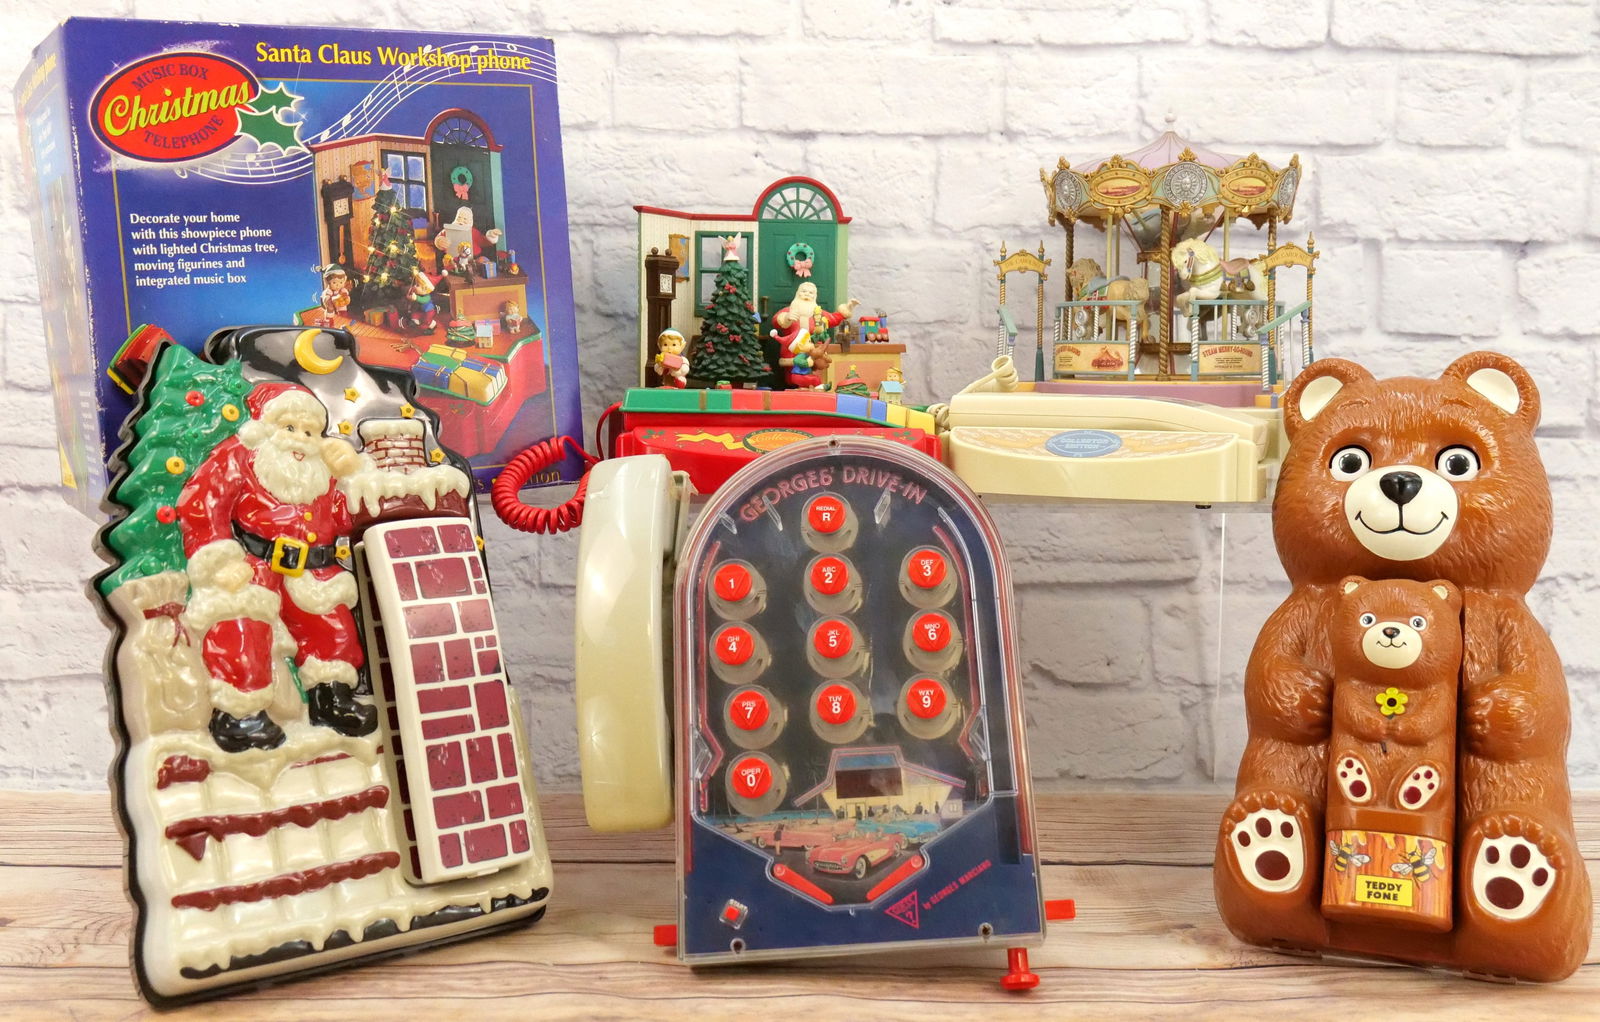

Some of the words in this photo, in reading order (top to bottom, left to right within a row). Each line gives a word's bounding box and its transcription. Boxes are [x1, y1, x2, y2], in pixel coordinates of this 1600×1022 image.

[256, 42, 312, 63] Santa
[318, 43, 372, 65] Claus
[377, 46, 471, 73] Workshop
[477, 49, 532, 74] phone
[131, 63, 175, 91] MUSIC
[179, 63, 209, 81] BOX
[104, 81, 249, 136] Christmas
[144, 114, 224, 149] TELEPHONE
[130, 213, 180, 224] Decorate
[183, 214, 208, 226] your
[211, 212, 240, 223] home
[131, 228, 156, 239] with
[159, 228, 179, 239] this
[181, 227, 237, 241] showpiece
[240, 226, 272, 240] phone
[133, 244, 157, 255] with
[160, 243, 197, 257] lighted
[200, 242, 252, 254] Christmas
[255, 243, 278, 254] tree,
[134, 259, 175, 273] moving
[177, 258, 223, 272] figurines
[226, 257, 245, 268] and
[136, 274, 190, 289] integrated
[194, 273, 224, 284] music
[227, 272, 246, 283] box
[843, 466, 927, 504] DRIVE-IN
[822, 513, 831, 521] R
[923, 565, 932, 577] 3
[728, 578, 735, 589] 1
[824, 573, 833, 583] 2
[928, 629, 937, 641] 6
[728, 642, 738, 652] 4
[828, 636, 838, 647] 5
[922, 695, 931, 708] 9
[744, 707, 754, 719] 7
[831, 702, 841, 714] 8
[741, 767, 761, 776] OPER
[746, 774, 756, 787] 0
[1365, 880, 1402, 892] TEDDY
[1367, 890, 1399, 901] FONE
